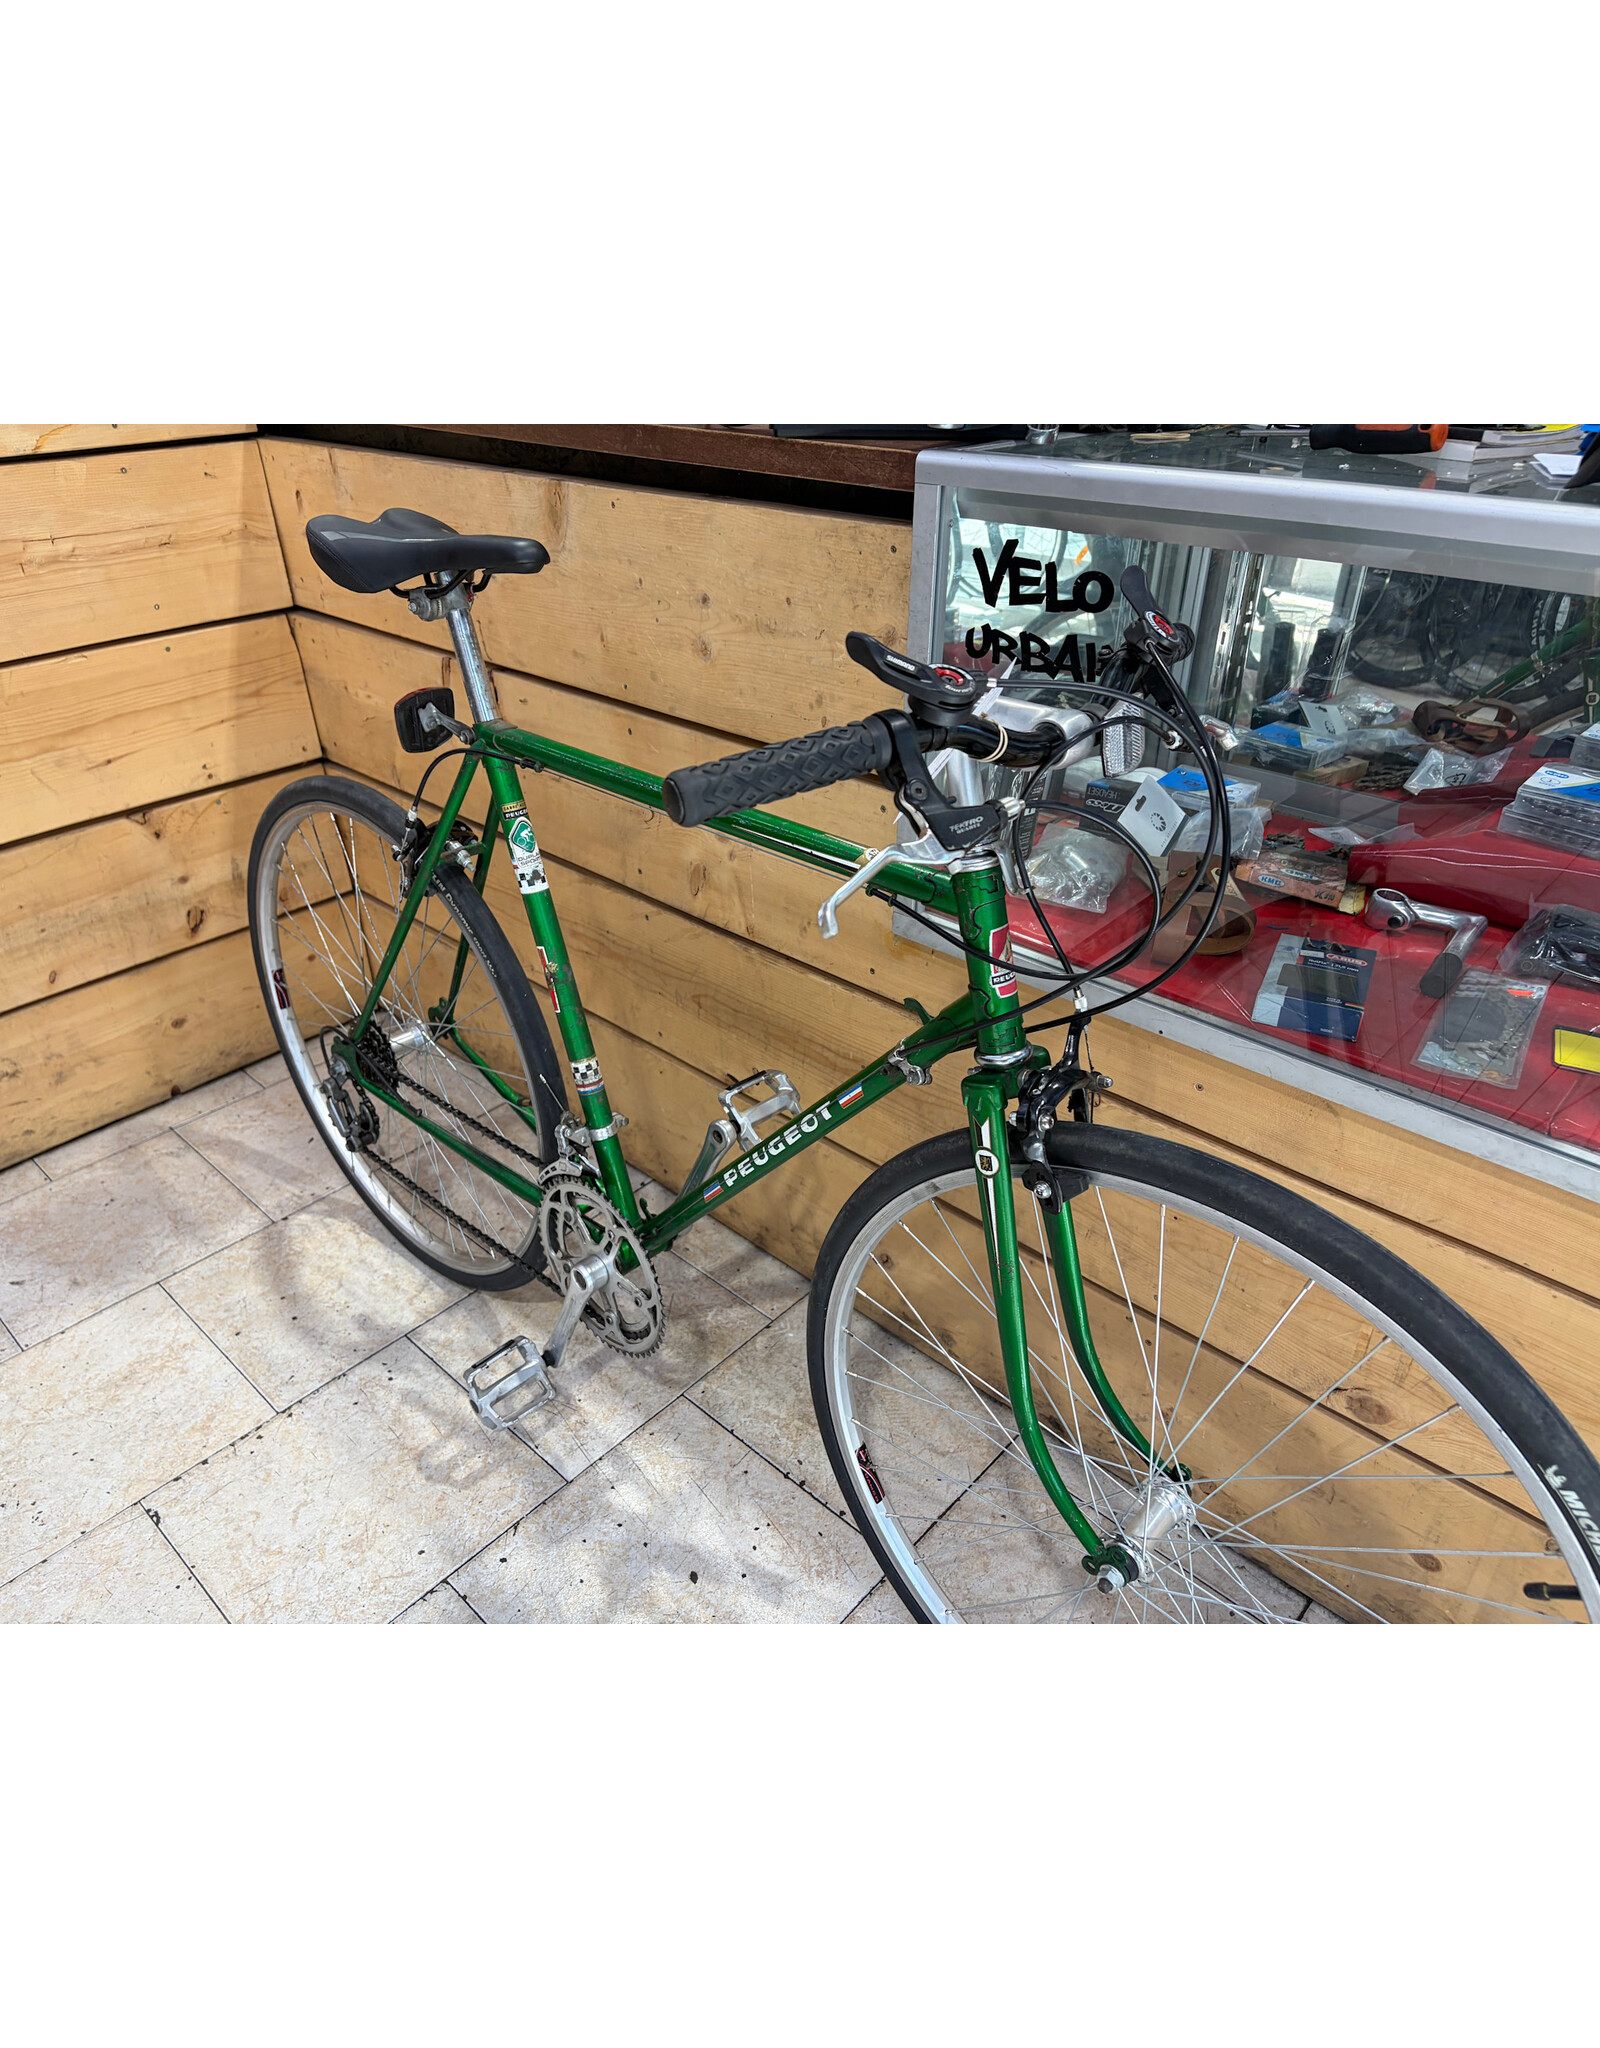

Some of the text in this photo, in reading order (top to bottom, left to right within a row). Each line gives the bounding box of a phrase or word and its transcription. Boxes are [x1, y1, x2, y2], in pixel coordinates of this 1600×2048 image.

[972, 539, 1115, 613] VELO
[965, 623, 1113, 683] URBAI
[949, 815, 984, 832] TEKTRO
[1261, 875, 1282, 888] KMC
[723, 1100, 833, 1188] PEUGEOT
